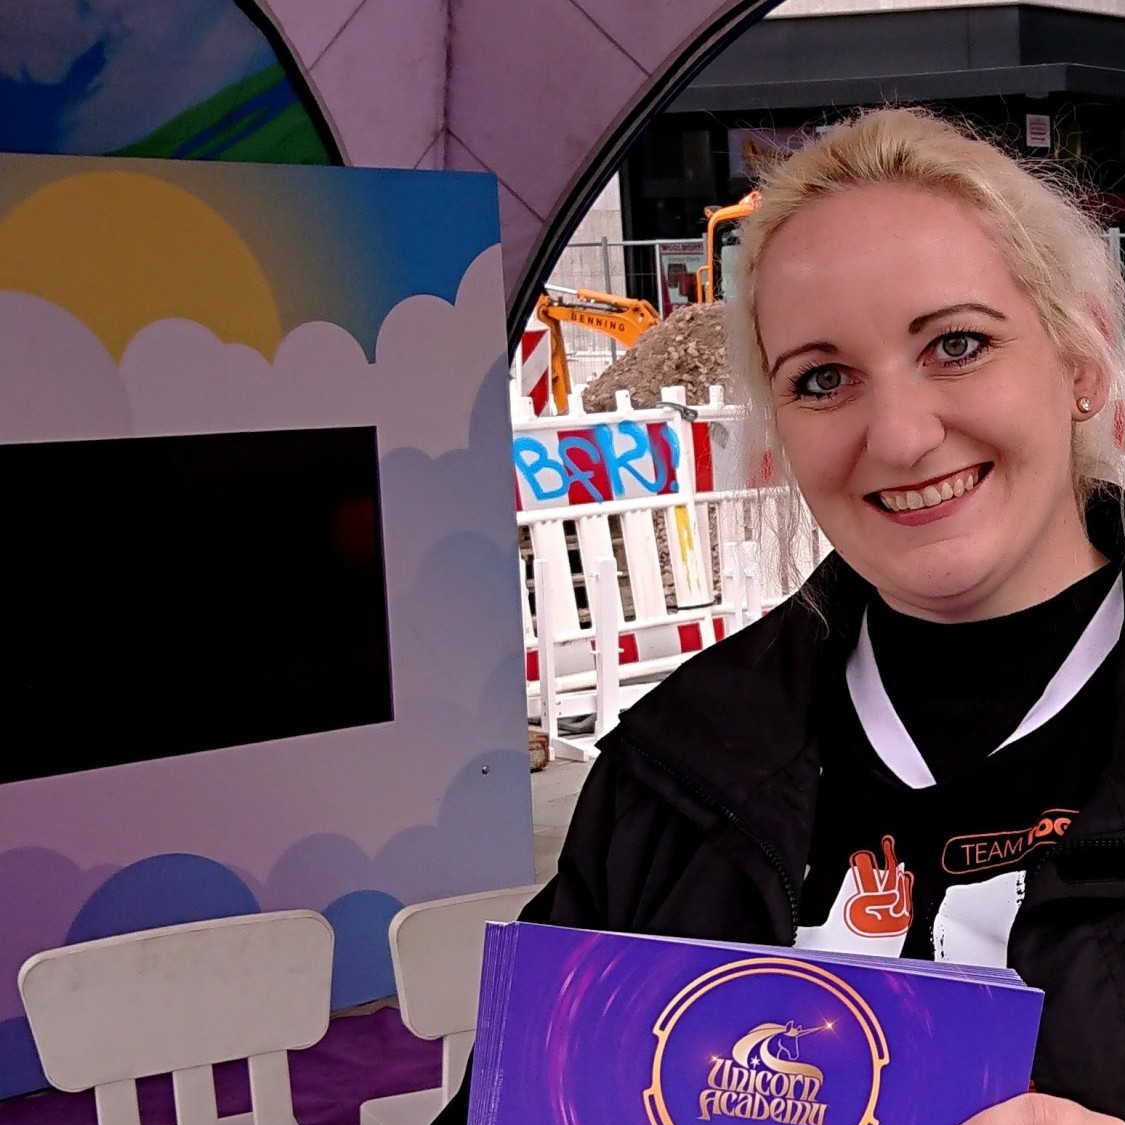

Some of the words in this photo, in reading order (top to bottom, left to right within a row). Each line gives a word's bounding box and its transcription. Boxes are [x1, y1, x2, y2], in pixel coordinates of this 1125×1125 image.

[571, 312, 625, 331] BENNING
[961, 837, 1023, 865] TEAM
[707, 1058, 821, 1102] Unicorn
